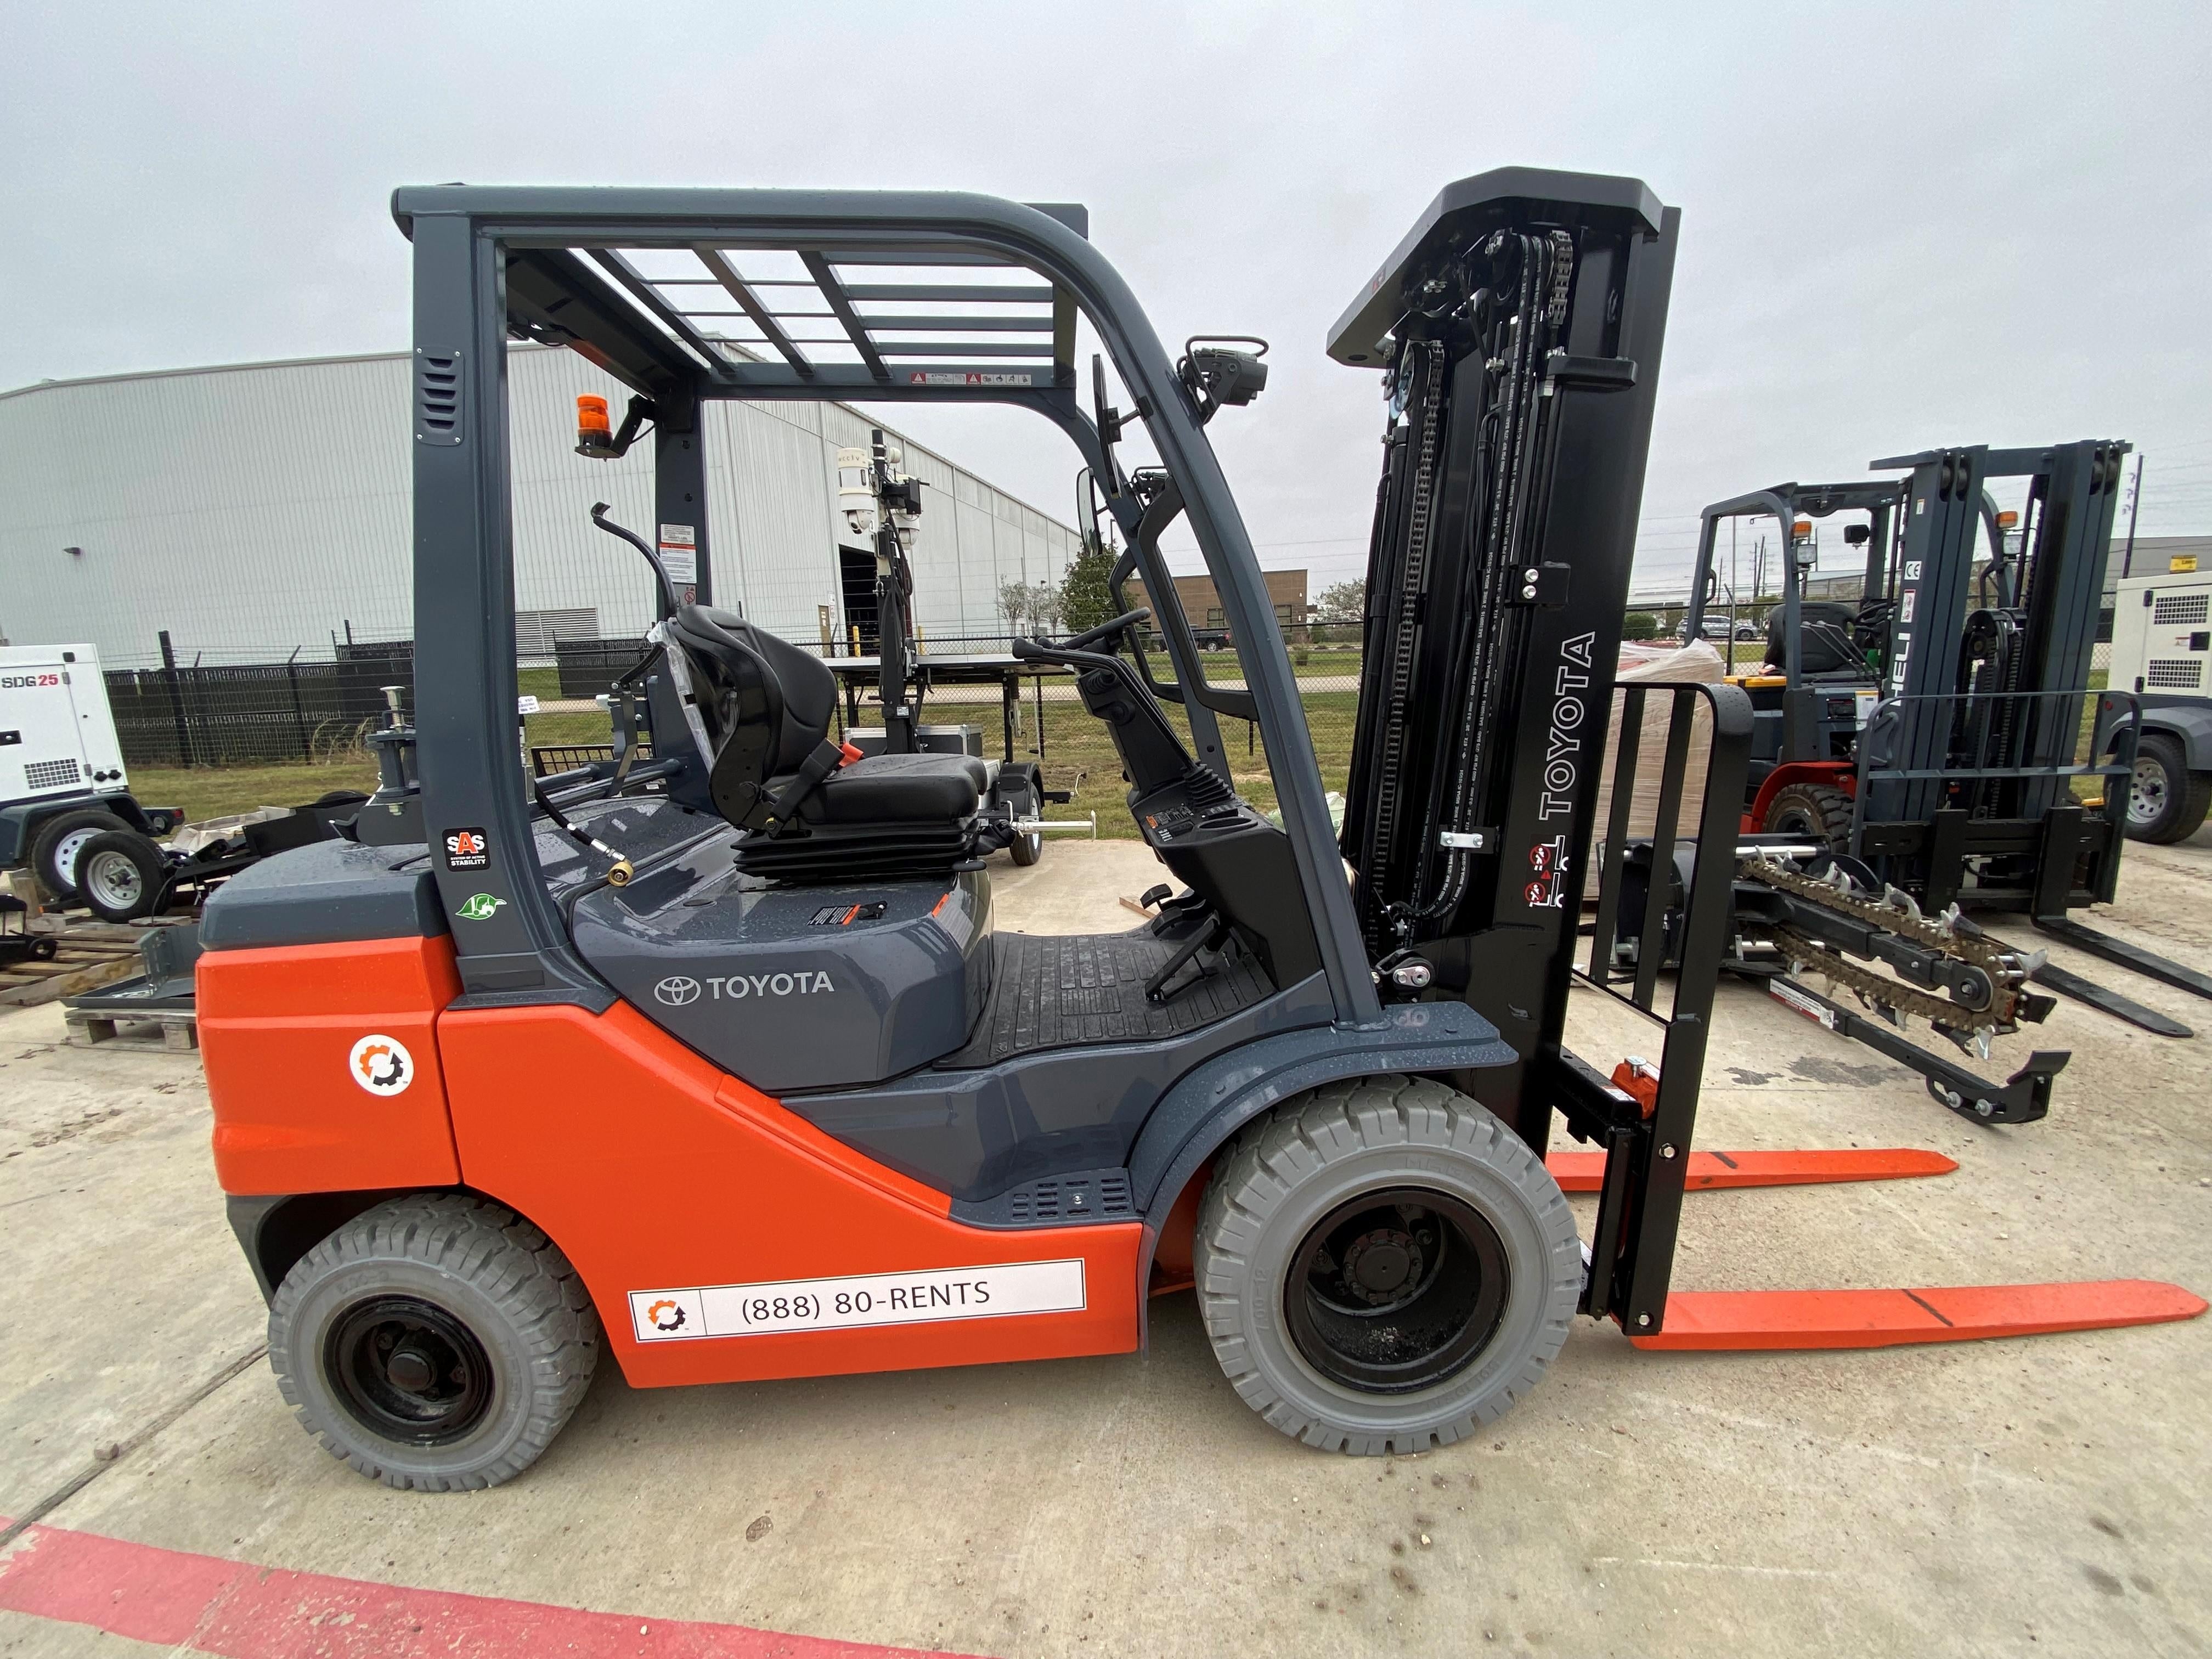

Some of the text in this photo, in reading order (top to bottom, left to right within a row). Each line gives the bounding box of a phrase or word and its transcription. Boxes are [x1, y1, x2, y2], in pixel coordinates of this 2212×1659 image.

[1906, 563, 1920, 577] CE
[1890, 633, 1911, 706] HELI
[1539, 631, 1595, 821] TOYOTA
[447, 832, 485, 854] SAS
[706, 970, 834, 1000] TOYOTA
[741, 1280, 991, 1325] (888) 80-RENTS
